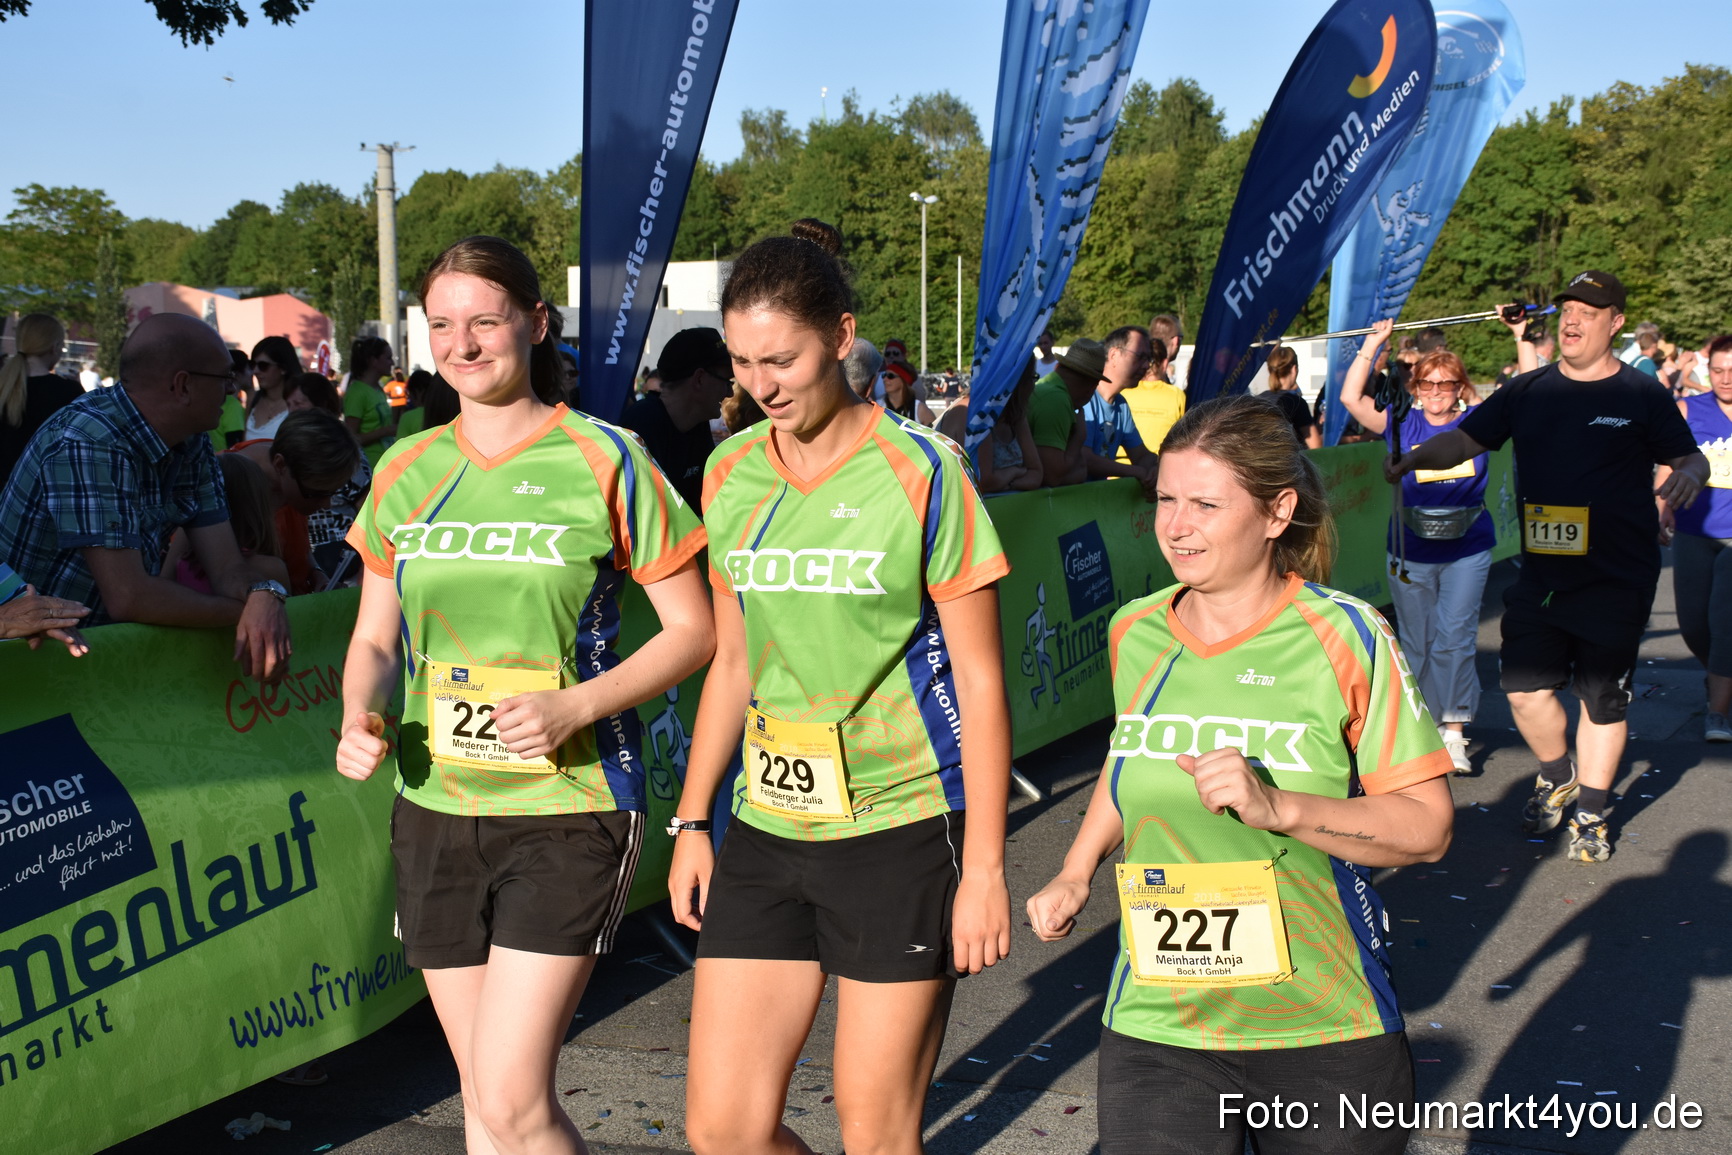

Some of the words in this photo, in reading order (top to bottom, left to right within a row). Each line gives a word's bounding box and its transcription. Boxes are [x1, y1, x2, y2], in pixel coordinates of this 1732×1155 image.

[1313, 171, 1348, 224] Druck
[1346, 141, 1370, 173] und
[1371, 70, 1420, 138] Medien
[1223, 111, 1364, 319] Frischmann
[392, 521, 571, 566] BOCK
[1530, 522, 1578, 541] 1119
[724, 548, 888, 595] BOCK
[1072, 550, 1101, 574] Fischer
[452, 739, 489, 752] Mederer
[465, 751, 480, 759] Bock
[1110, 714, 1312, 772] BOCK
[759, 751, 814, 793] 229
[760, 786, 799, 804] Feldberger
[801, 796, 823, 804] Julia
[101, 834, 133, 862] mit!
[15, 854, 45, 883] und
[48, 844, 76, 864] das
[1137, 884, 1185, 894] firmenlauf
[1129, 900, 1166, 911] walken
[1154, 909, 1239, 951] 227
[1156, 955, 1211, 965] Meinhardt
[1215, 955, 1243, 967] Anja
[1205, 967, 1231, 975] GmbH
